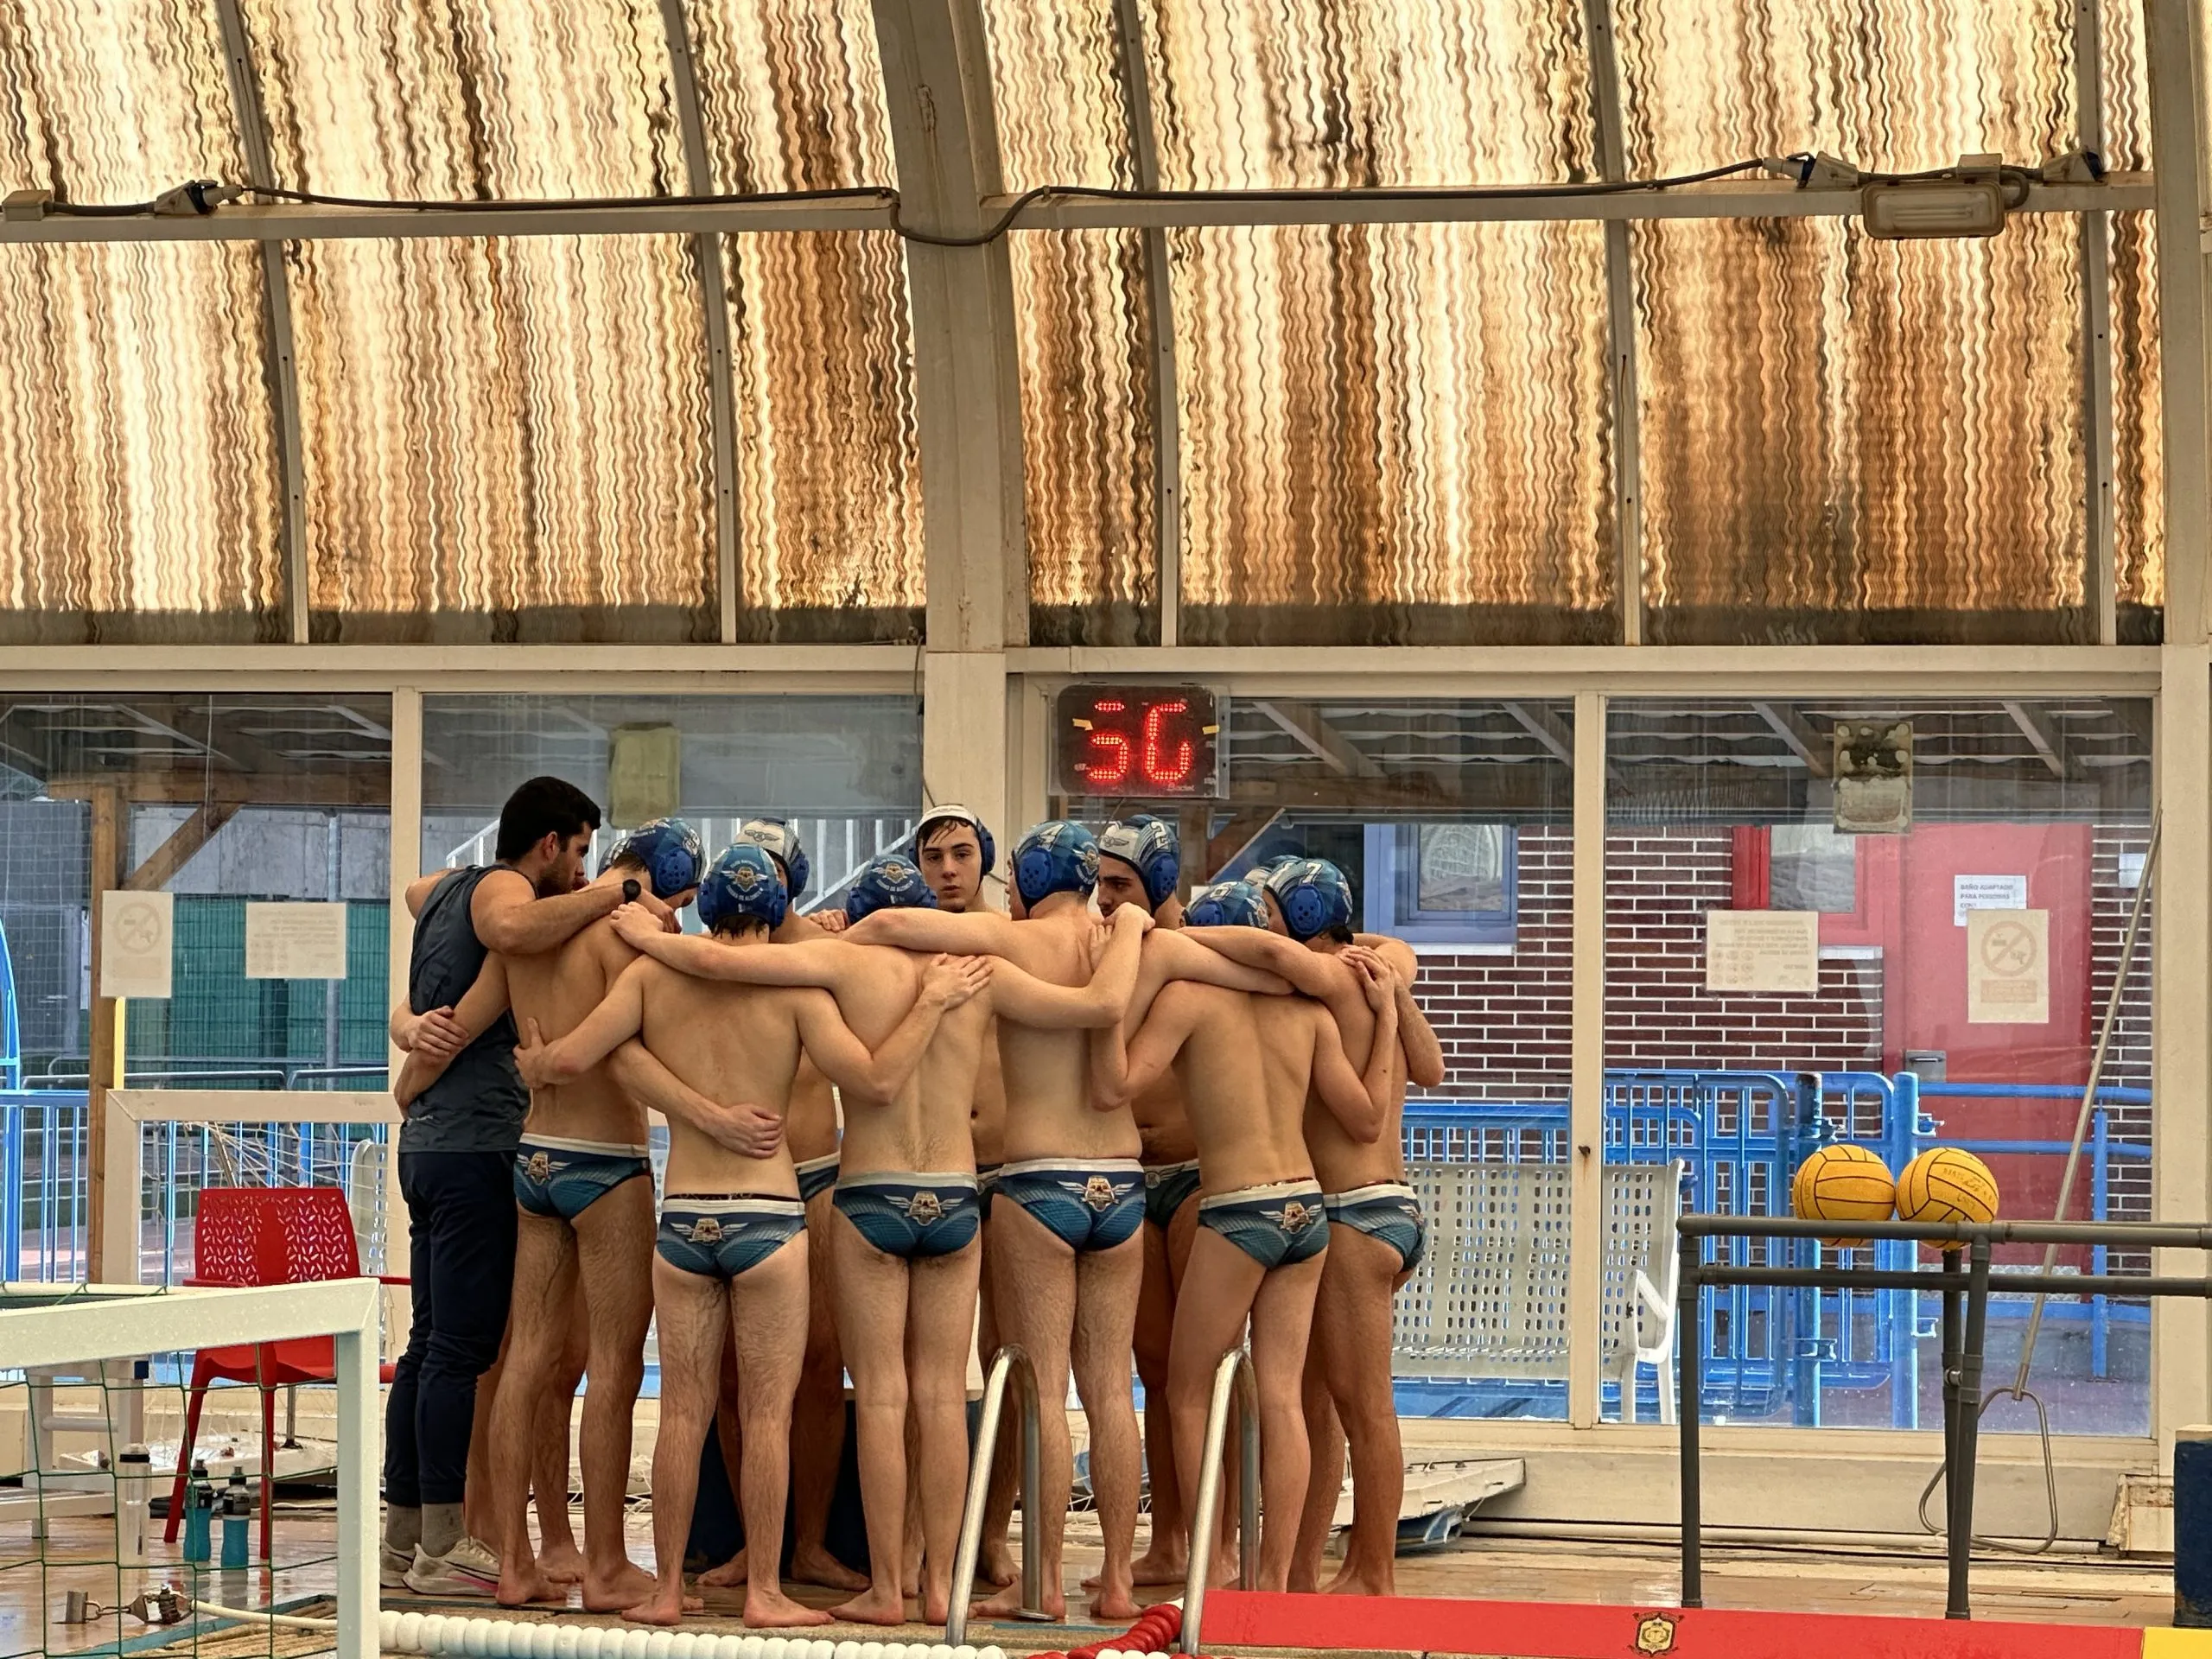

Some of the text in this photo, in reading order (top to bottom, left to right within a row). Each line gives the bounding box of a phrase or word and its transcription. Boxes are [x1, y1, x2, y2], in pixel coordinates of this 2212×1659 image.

[1038, 823, 1065, 851] 4
[1150, 821, 1169, 849] 2
[1302, 862, 1322, 884] 7
[1209, 881, 1239, 899] 6
